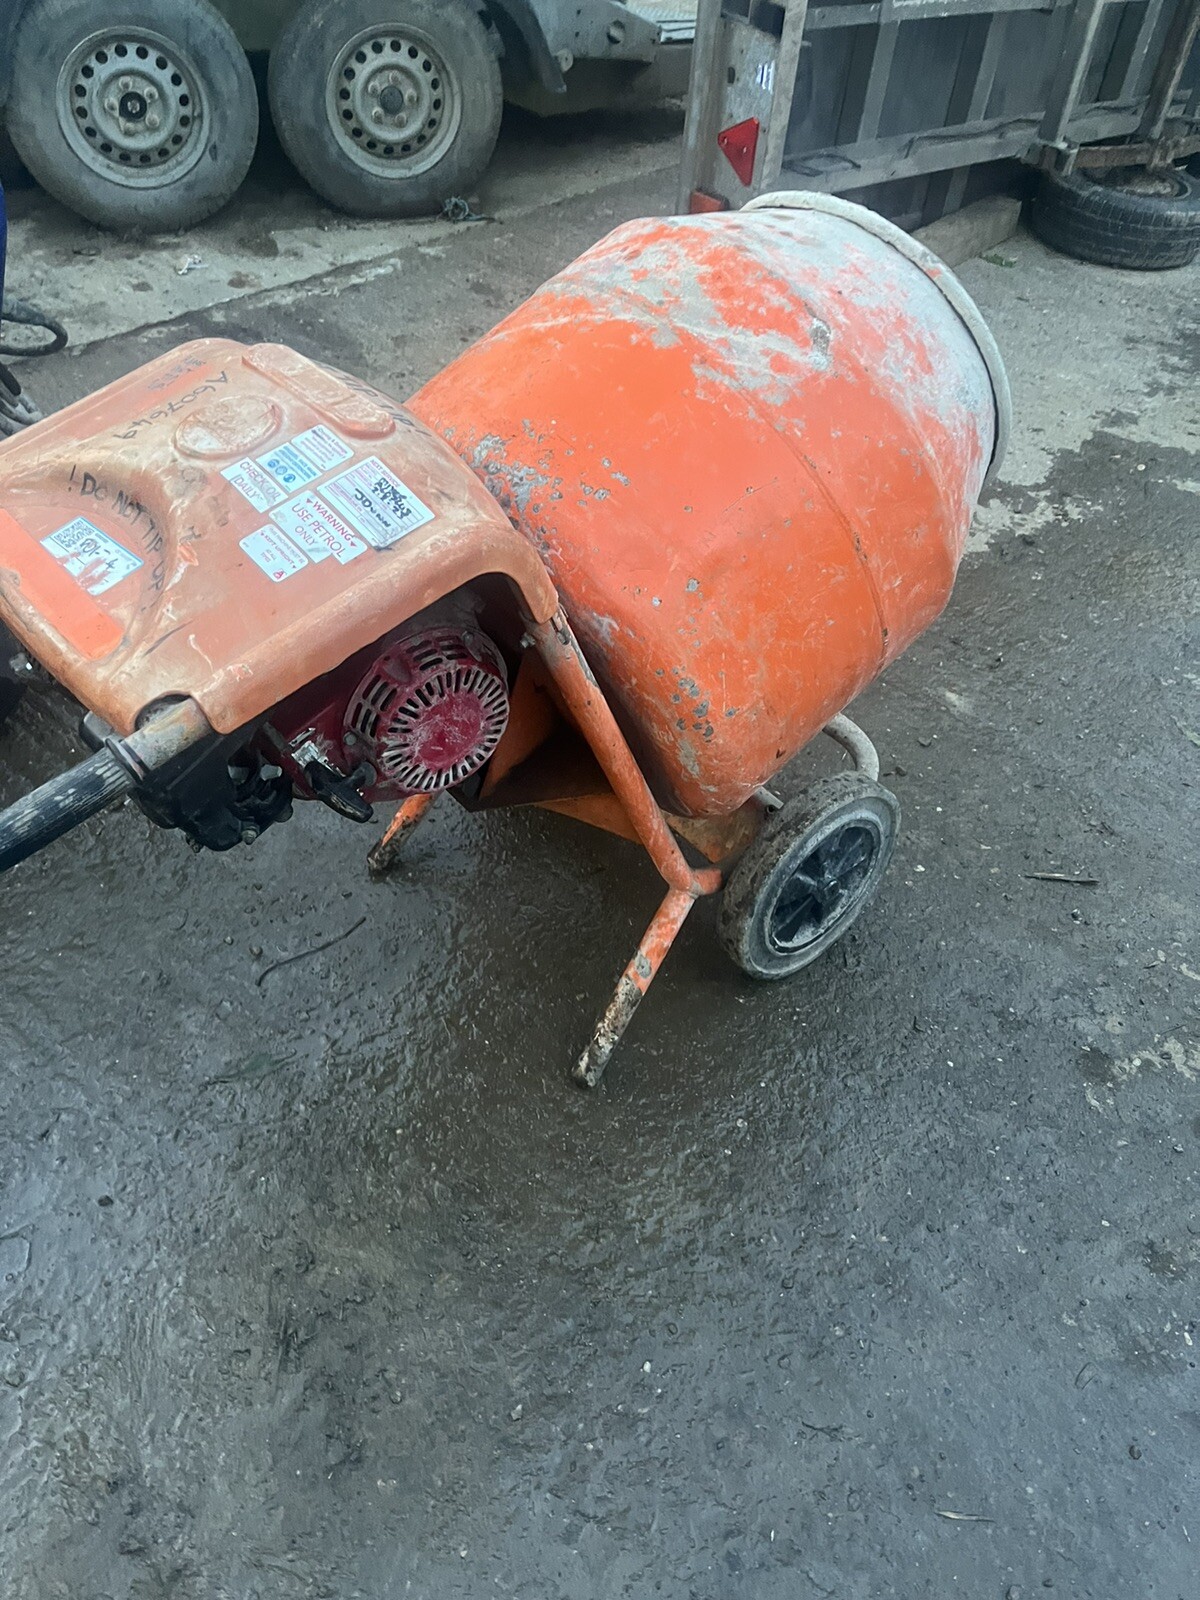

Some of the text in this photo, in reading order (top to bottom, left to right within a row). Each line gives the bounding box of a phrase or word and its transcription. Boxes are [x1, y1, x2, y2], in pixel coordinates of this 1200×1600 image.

[233, 476, 259, 498] DAILY
[238, 460, 270, 488] CHECK
[264, 486, 283, 501] OIL
[111, 489, 150, 525] NOT
[142, 517, 164, 555] TIP
[290, 502, 349, 557] USE PETROL
[293, 524, 318, 546] ONLY
[310, 501, 354, 541] WARNING
